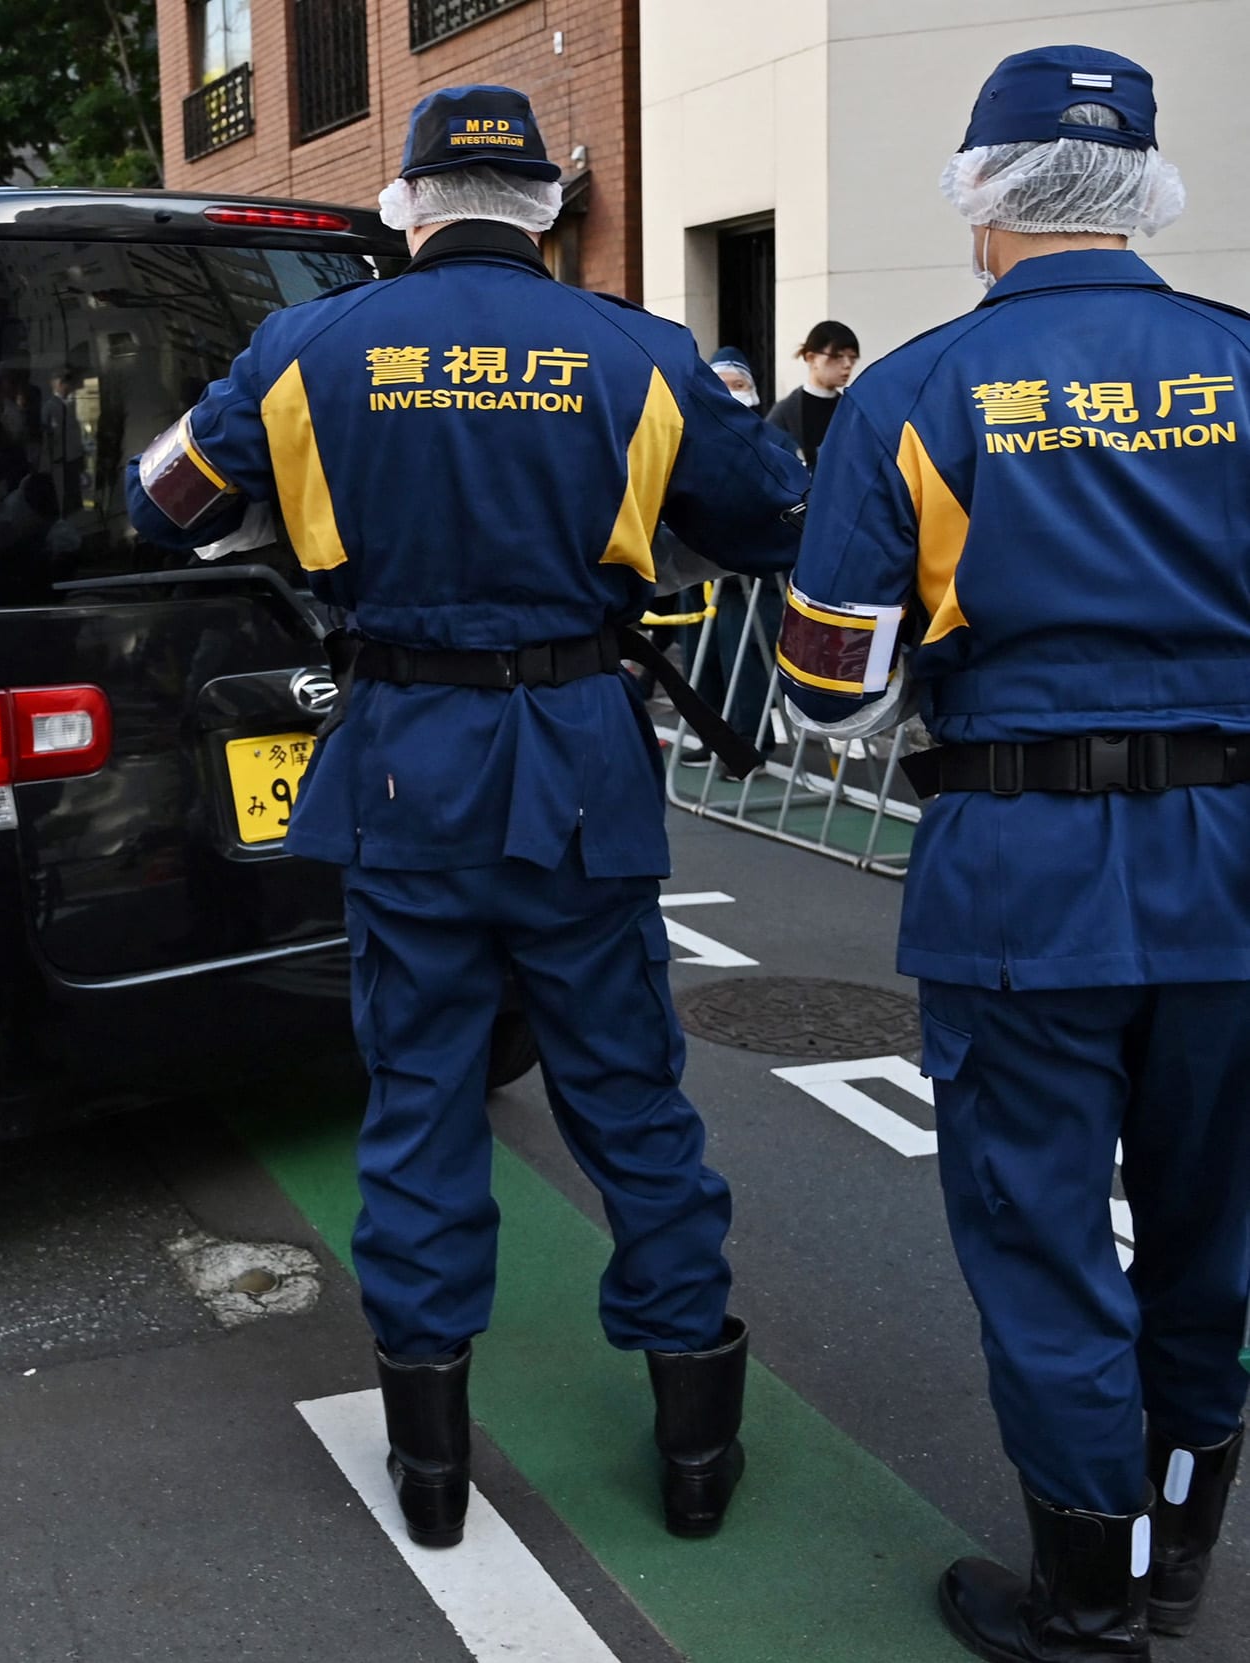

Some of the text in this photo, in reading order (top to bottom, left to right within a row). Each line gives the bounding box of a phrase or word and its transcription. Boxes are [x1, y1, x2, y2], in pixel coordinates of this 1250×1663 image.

[466, 119, 510, 132] MPD
[450, 137, 524, 147] INVESTIGATION
[365, 345, 589, 386] 警視庁
[369, 389, 583, 413] INVESTIGATION
[971, 373, 1235, 425] 警視庁
[985, 421, 1236, 454] INVESTIGATION
[268, 742, 309, 769] 多摩
[247, 796, 267, 817] み
